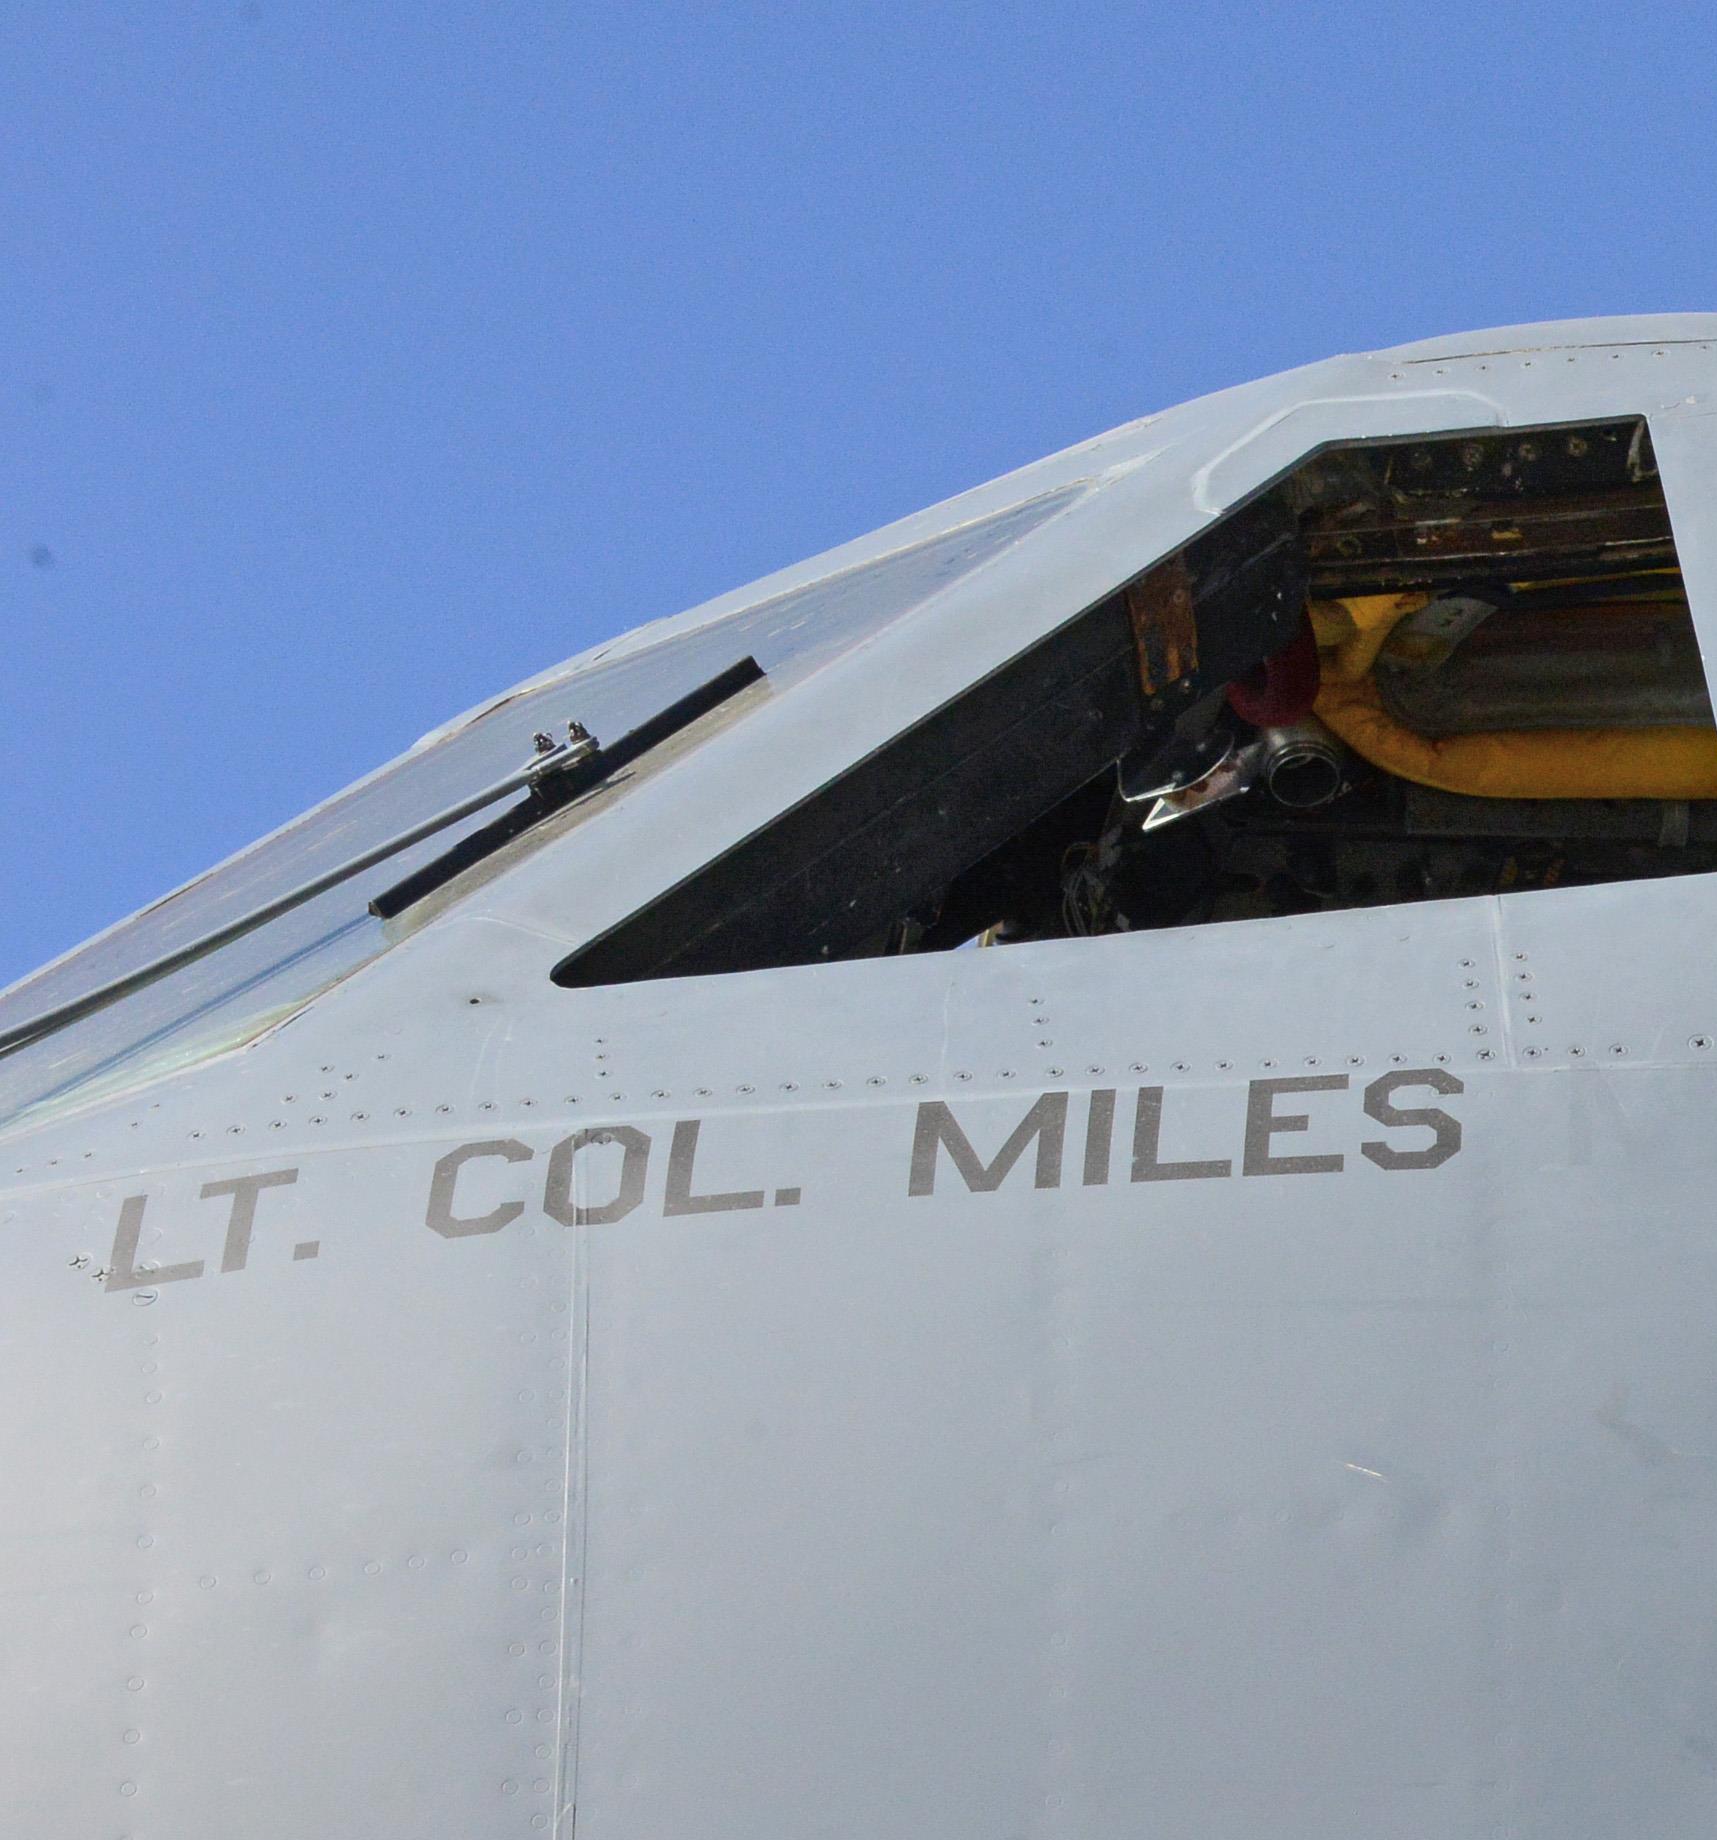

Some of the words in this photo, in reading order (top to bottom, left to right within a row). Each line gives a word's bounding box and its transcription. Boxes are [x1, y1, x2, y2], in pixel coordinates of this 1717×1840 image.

[105, 1168, 320, 1292] LT.
[424, 1119, 802, 1239] COL.
[907, 1068, 1466, 1197] MILES
